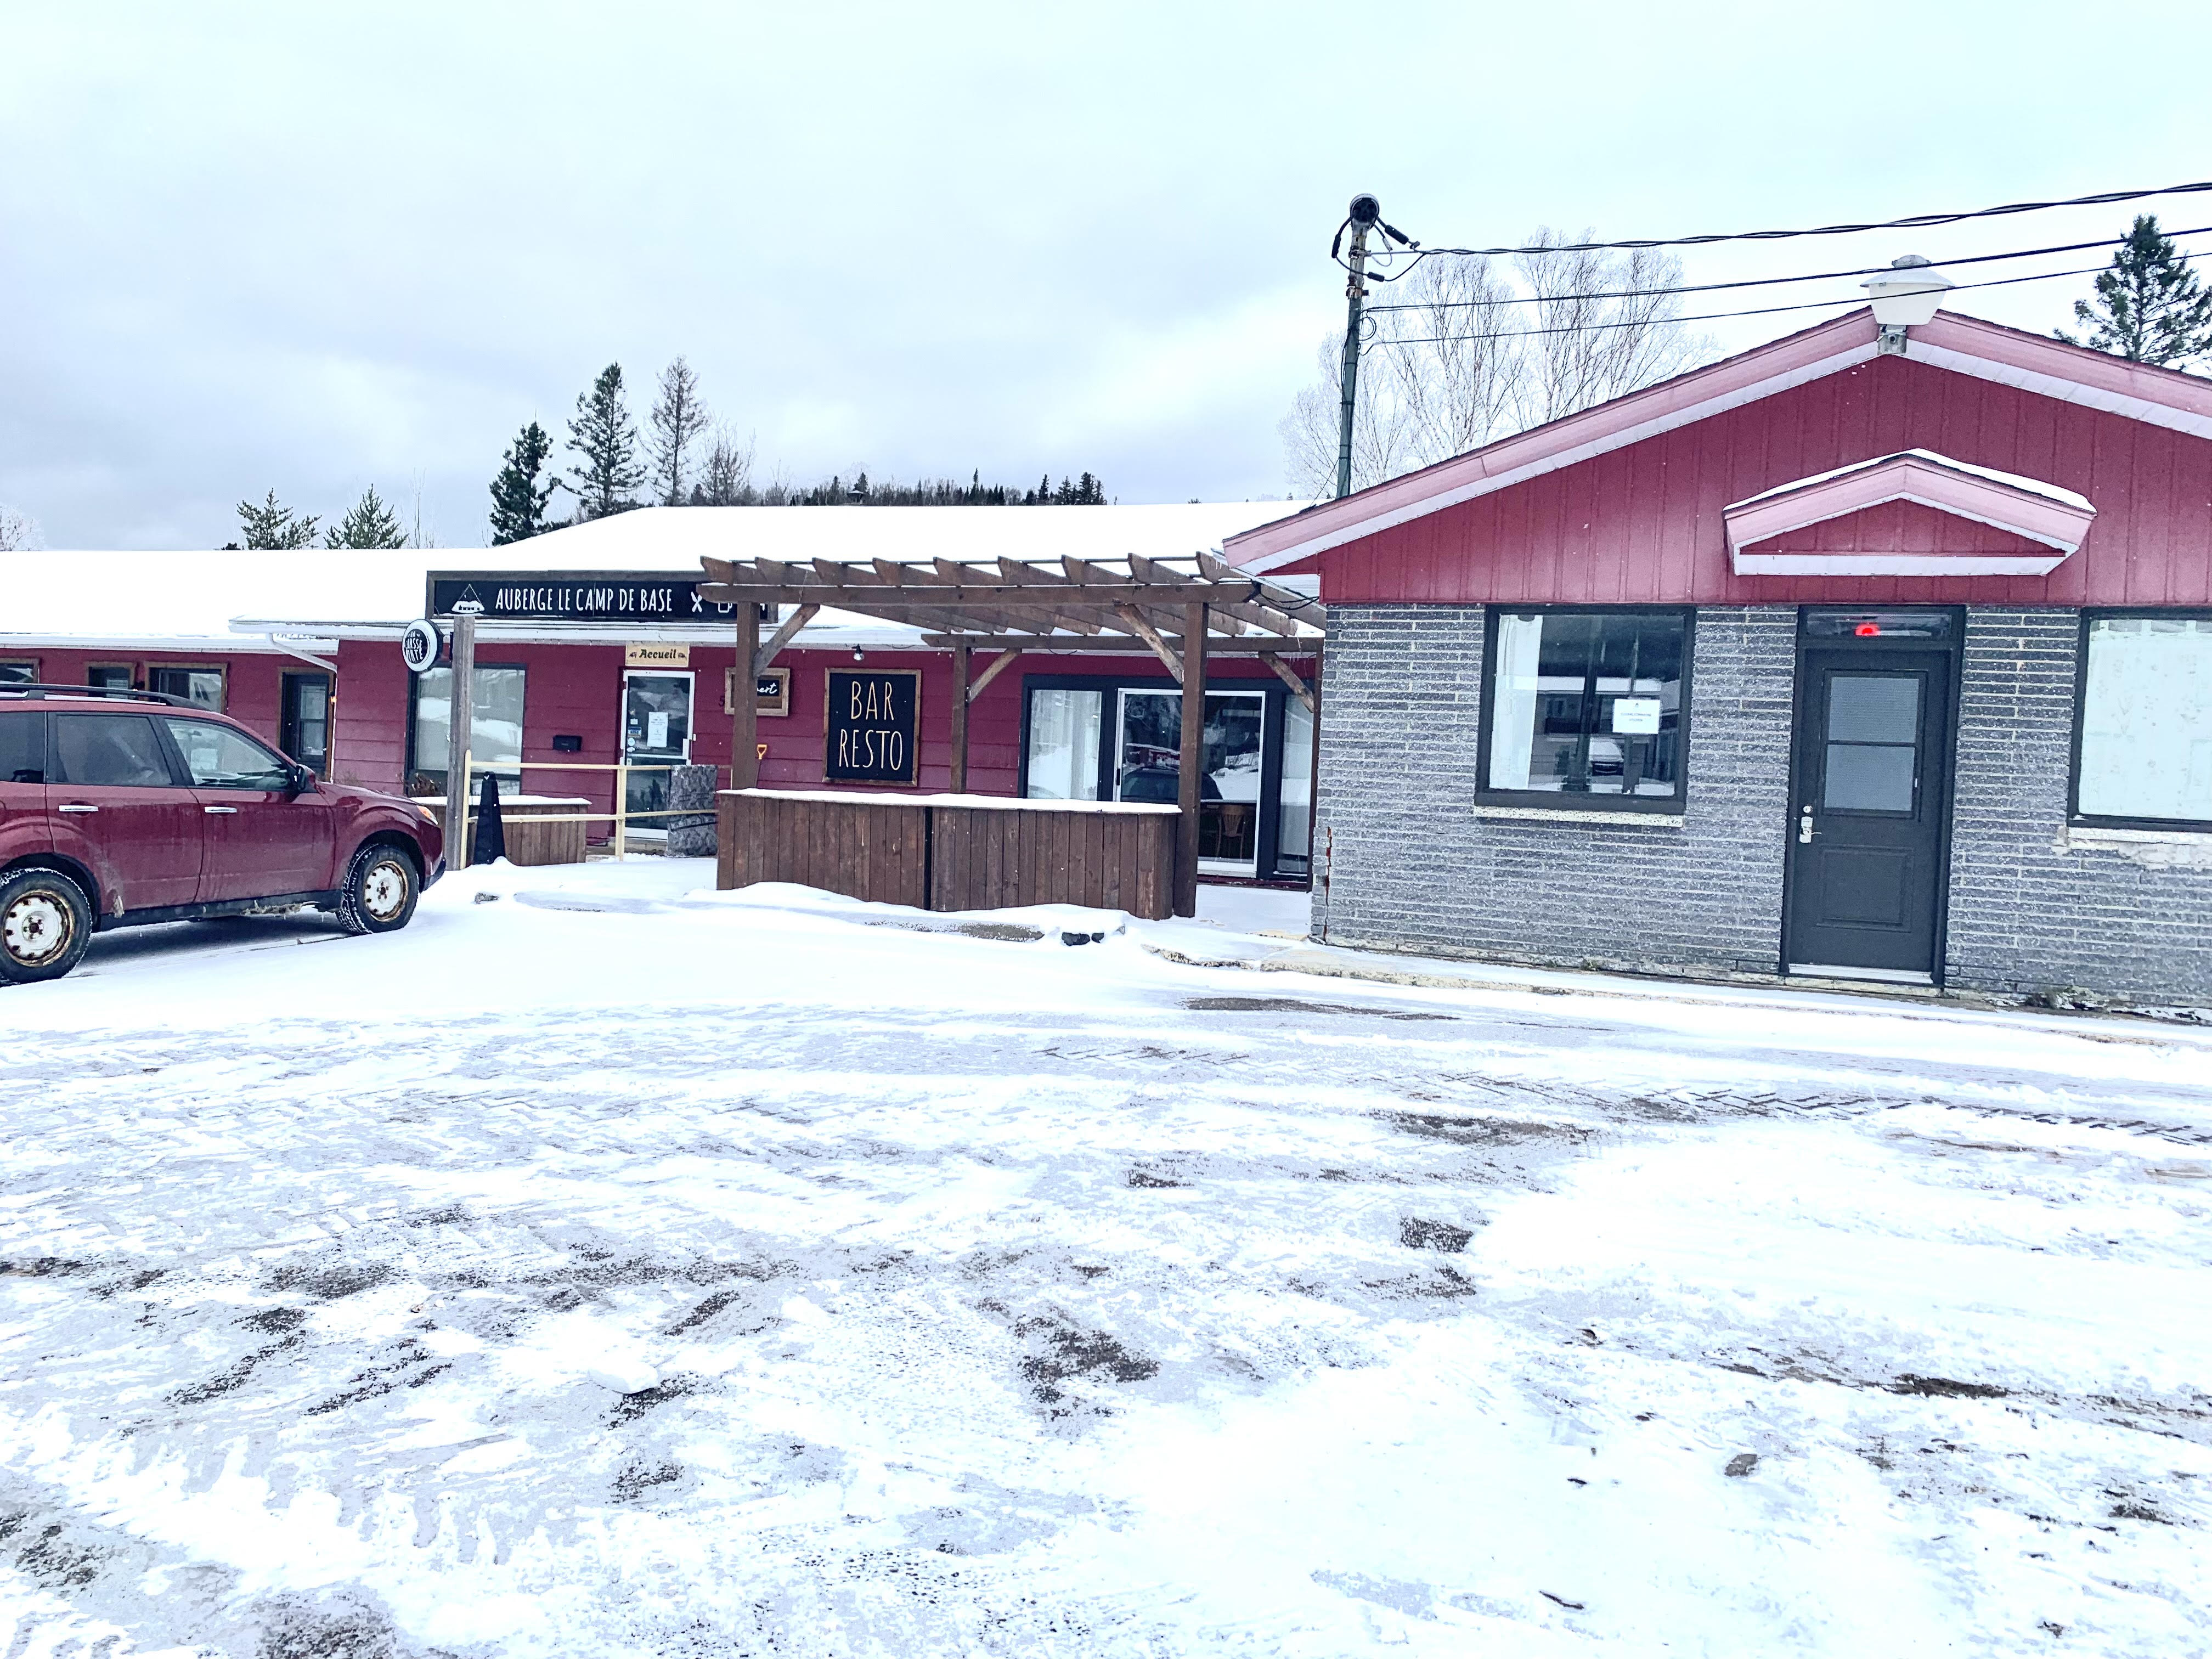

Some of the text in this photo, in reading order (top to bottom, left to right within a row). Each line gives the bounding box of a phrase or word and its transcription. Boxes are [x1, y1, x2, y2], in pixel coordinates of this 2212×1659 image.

[495, 588, 673, 611] AUBERGE LE CAMP DE BASE
[639, 648, 677, 659] Accueil
[851, 681, 894, 720] BAR
[839, 729, 902, 771] RESTO
